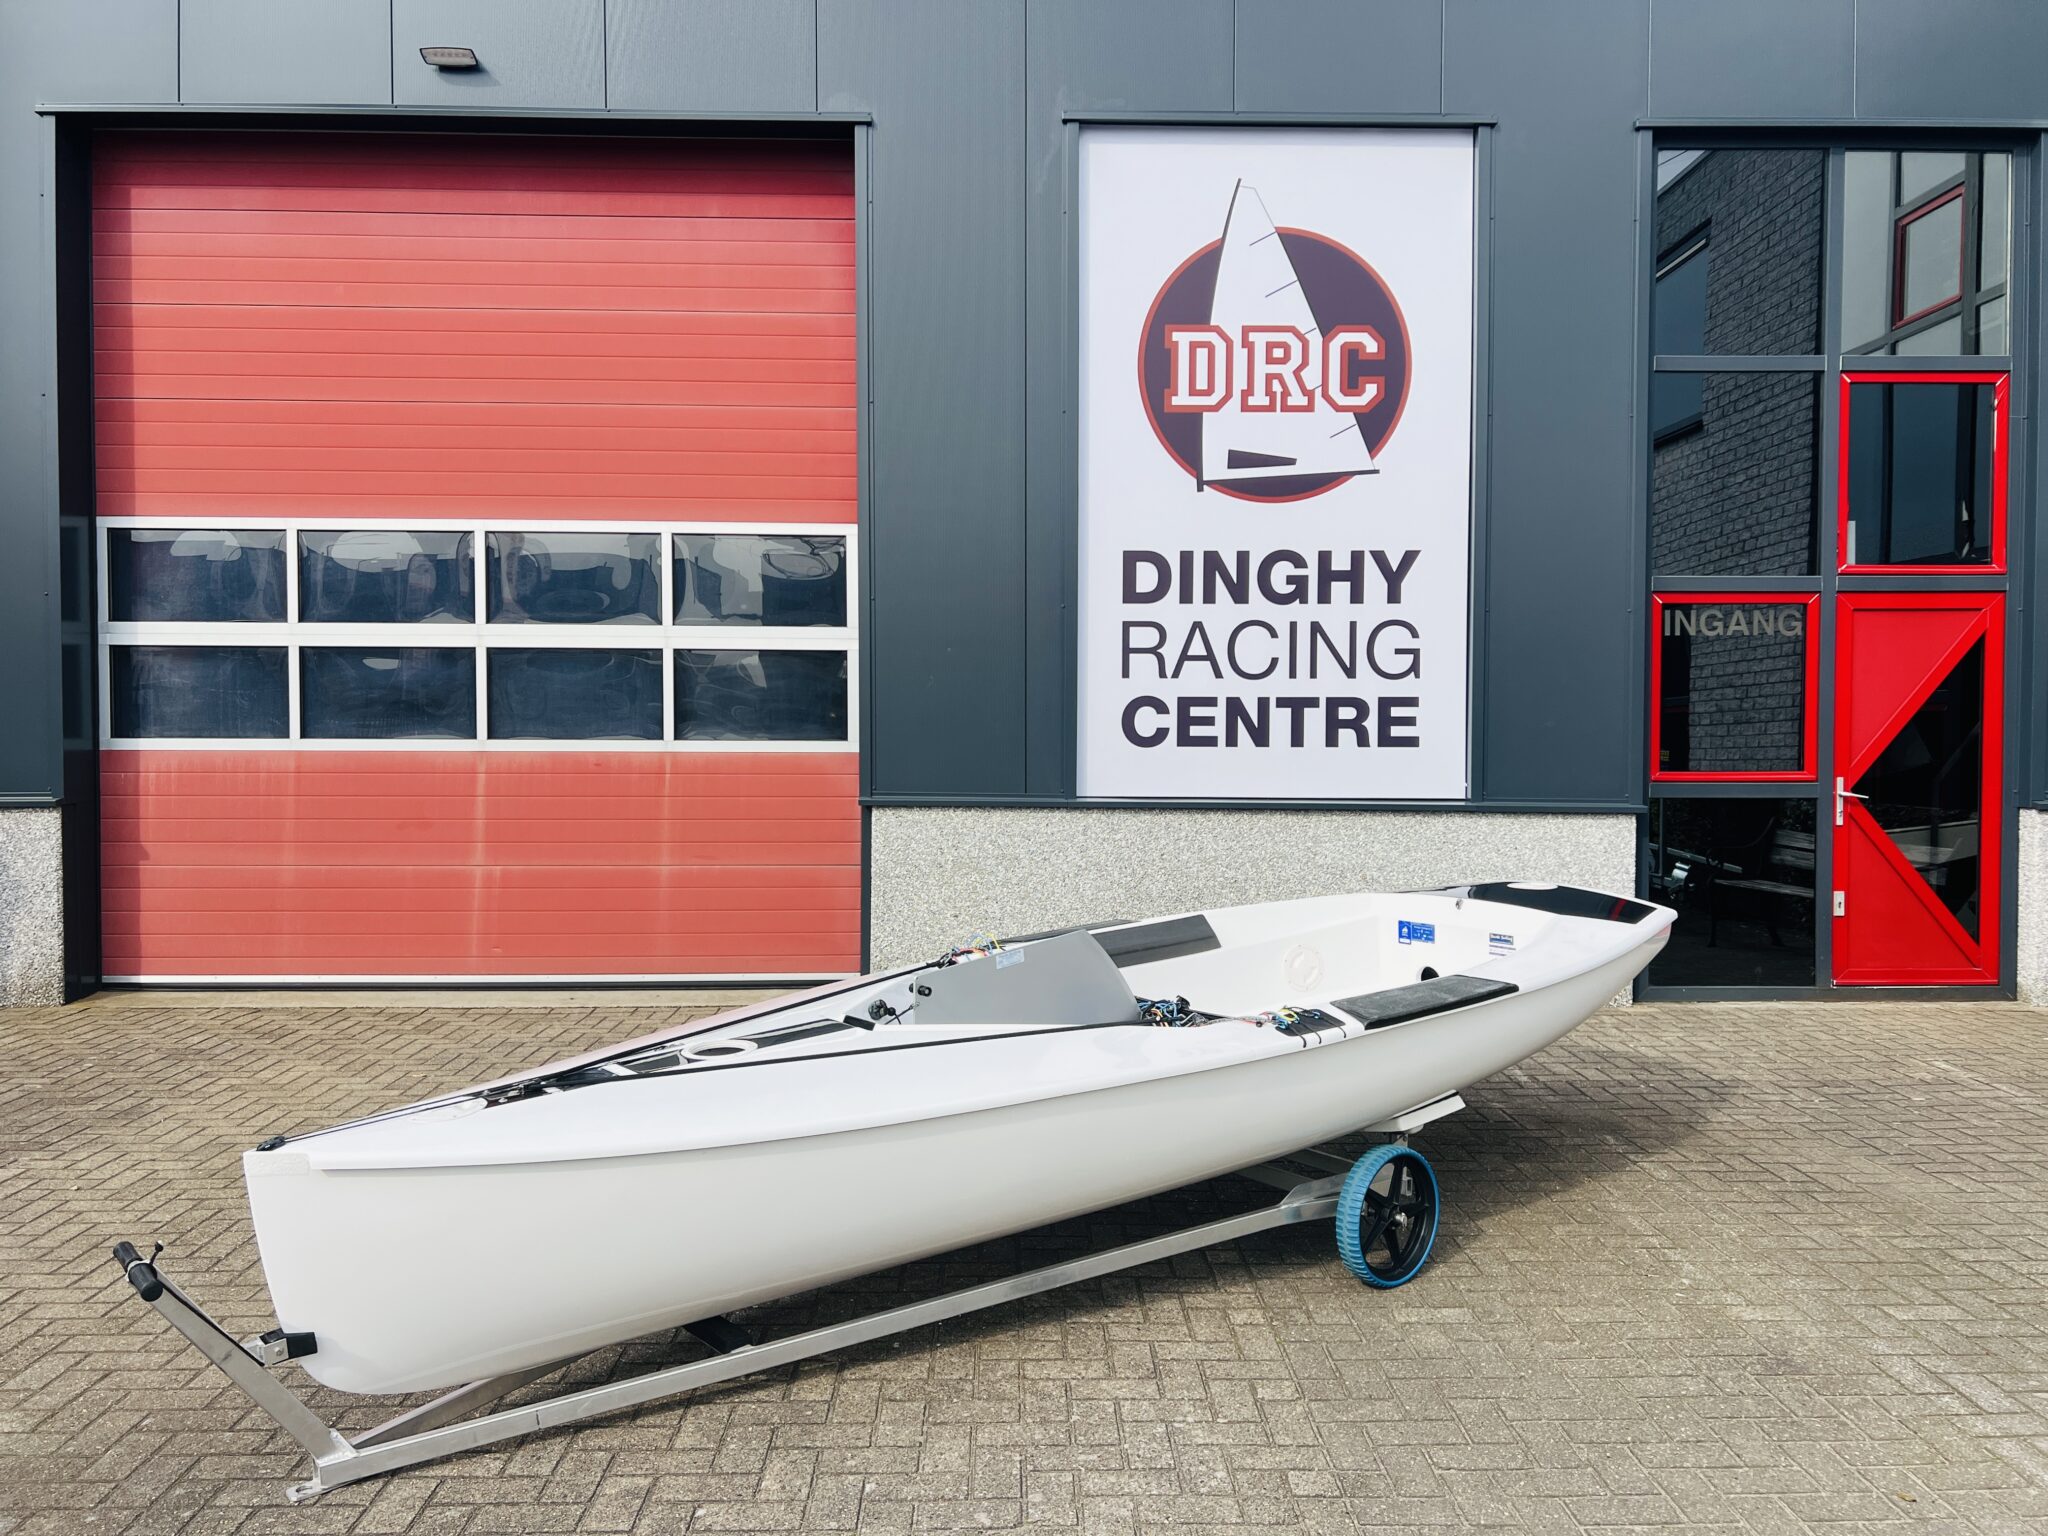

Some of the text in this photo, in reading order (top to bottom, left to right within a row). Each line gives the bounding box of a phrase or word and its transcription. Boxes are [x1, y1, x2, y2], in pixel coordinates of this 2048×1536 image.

[1164, 325, 1386, 413] DRC
[1122, 549, 1421, 605] DINGHY
[1122, 619, 1420, 680] RACING
[1664, 609, 1803, 637] INGANG
[1121, 695, 1419, 748] CENTRE
